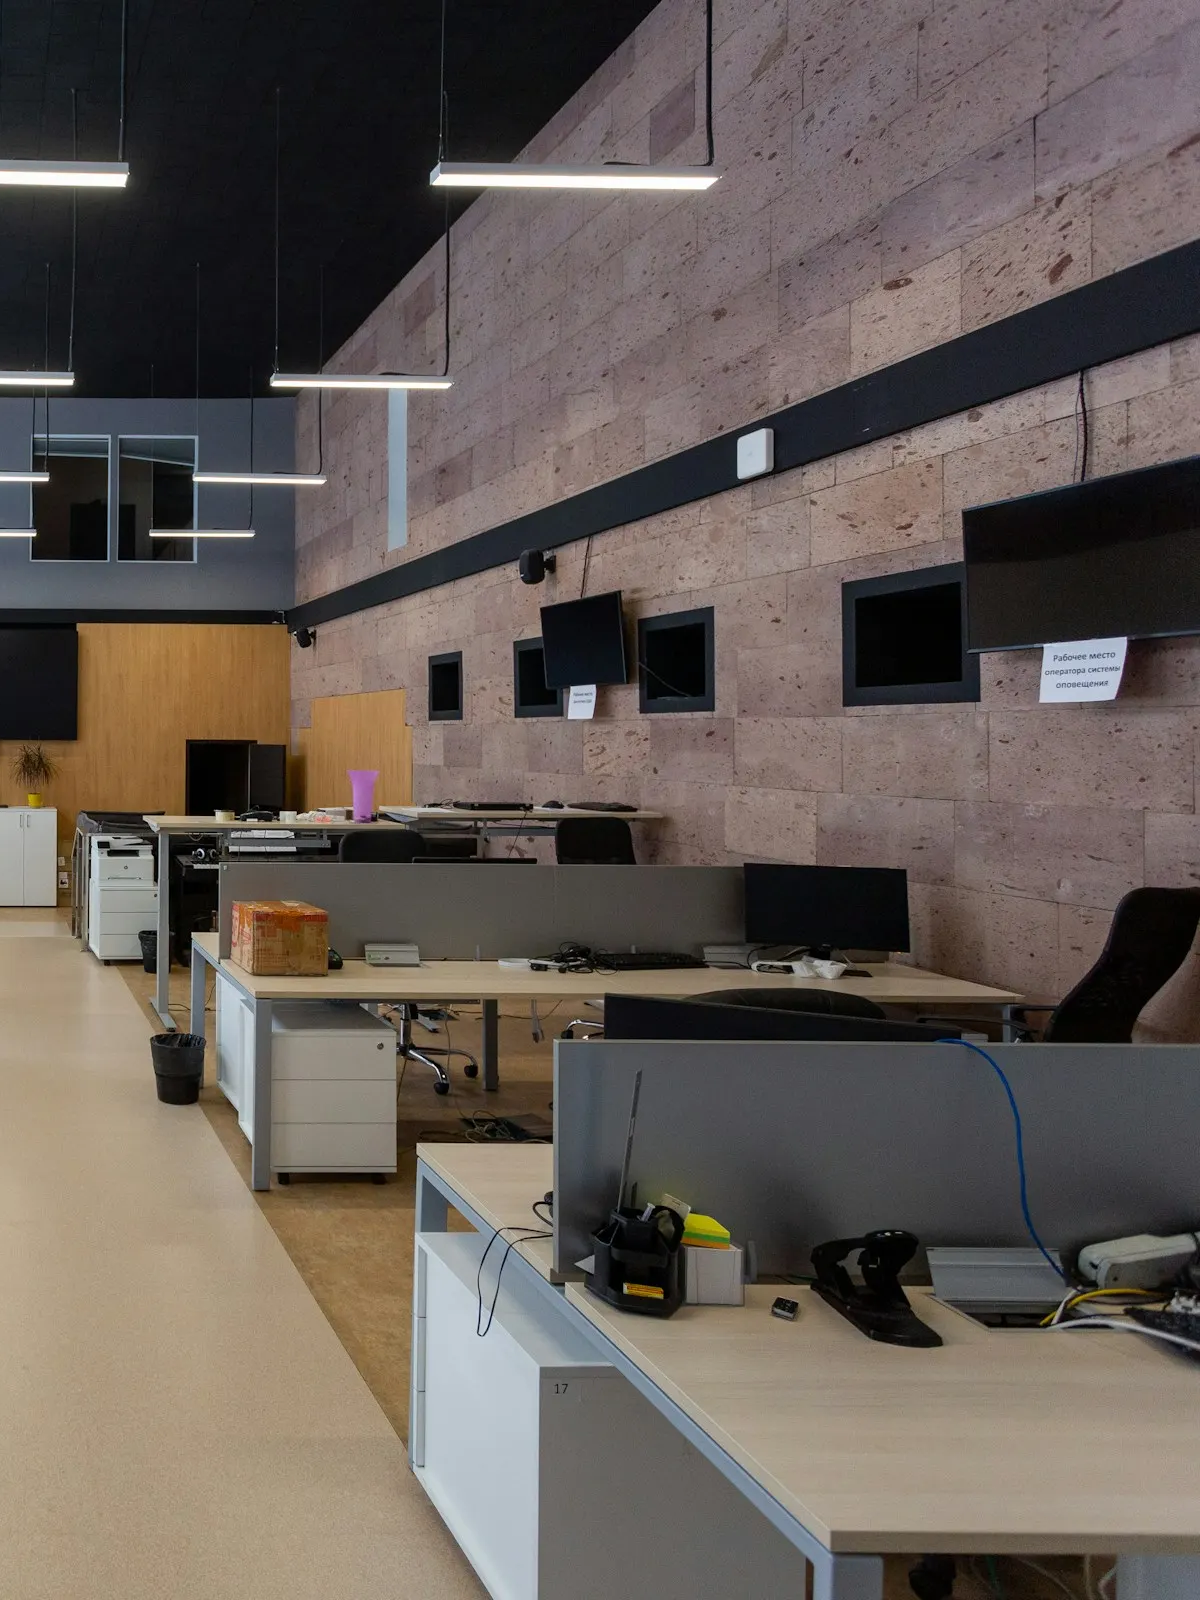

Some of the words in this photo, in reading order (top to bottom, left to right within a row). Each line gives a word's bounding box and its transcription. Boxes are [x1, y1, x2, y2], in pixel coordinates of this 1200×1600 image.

[1053, 653, 1087, 662] Рабочее
[1044, 668, 1086, 676] оператора
[1088, 665, 1121, 673] системы
[1056, 680, 1109, 688] оповещения
[554, 1383, 569, 1394] 17
